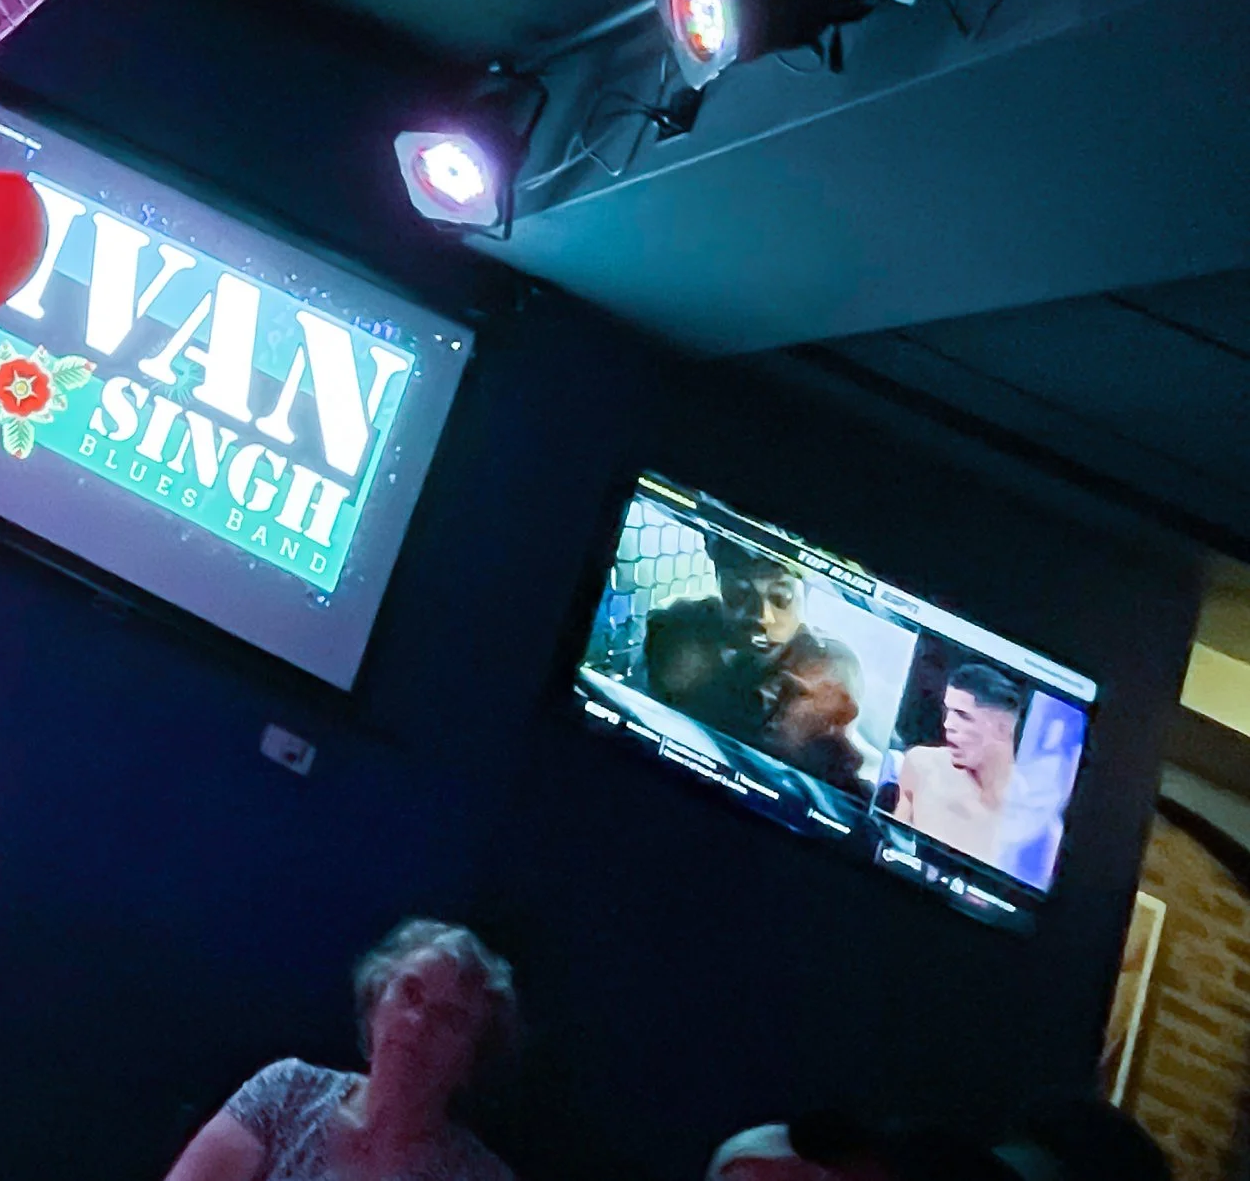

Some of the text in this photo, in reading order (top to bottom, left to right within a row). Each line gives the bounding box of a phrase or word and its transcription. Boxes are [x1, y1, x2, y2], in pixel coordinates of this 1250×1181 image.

[7, 180, 409, 477] IVAN
[78, 433, 328, 574] BLUES BAND
[90, 376, 350, 547] SINGH
